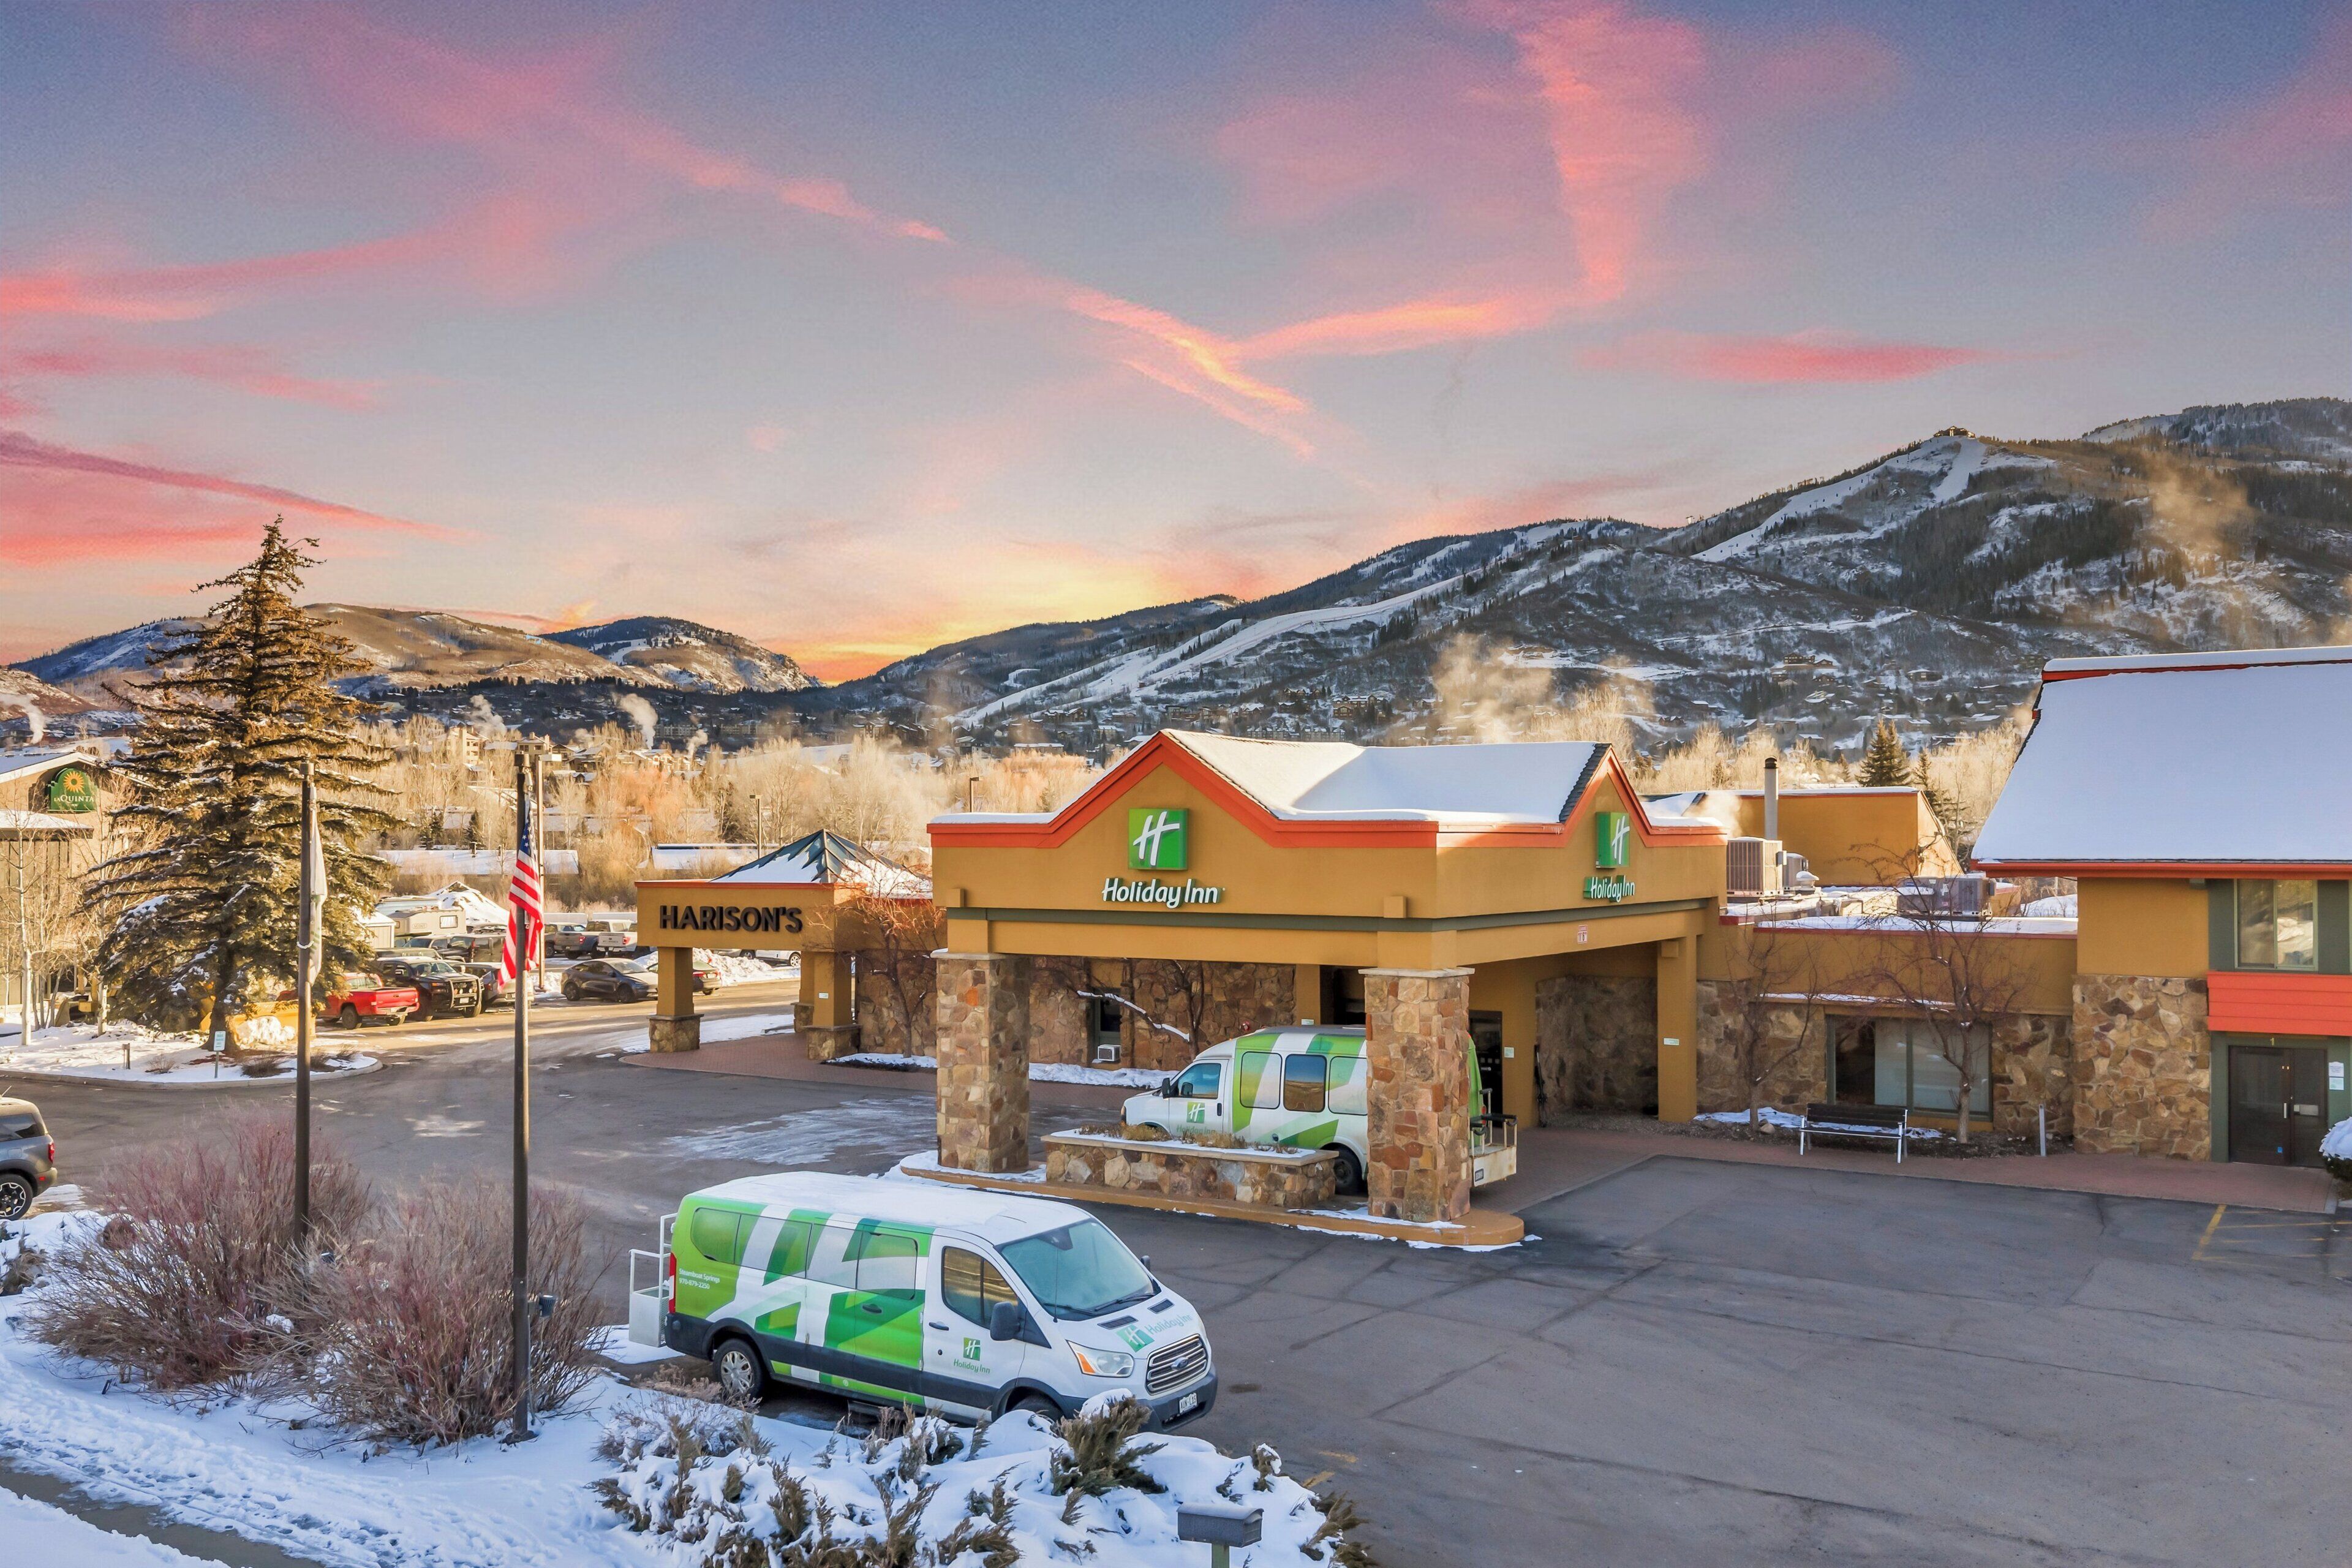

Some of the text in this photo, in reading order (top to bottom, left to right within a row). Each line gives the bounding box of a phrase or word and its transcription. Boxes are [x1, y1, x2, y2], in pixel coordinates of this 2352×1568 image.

[60, 794, 94, 803] QUINTA
[1102, 878, 1218, 909] Holiday Inn
[1591, 875, 1635, 902] Holiday Inn
[660, 905, 804, 933] HARISON'S
[2270, 1038, 2275, 1046] 1
[679, 1268, 720, 1284] Steamboat Springs
[679, 1278, 710, 1289] 970-879-2250
[1144, 1318, 1185, 1335] Holiday
[954, 1359, 990, 1374] Holiday Inn
